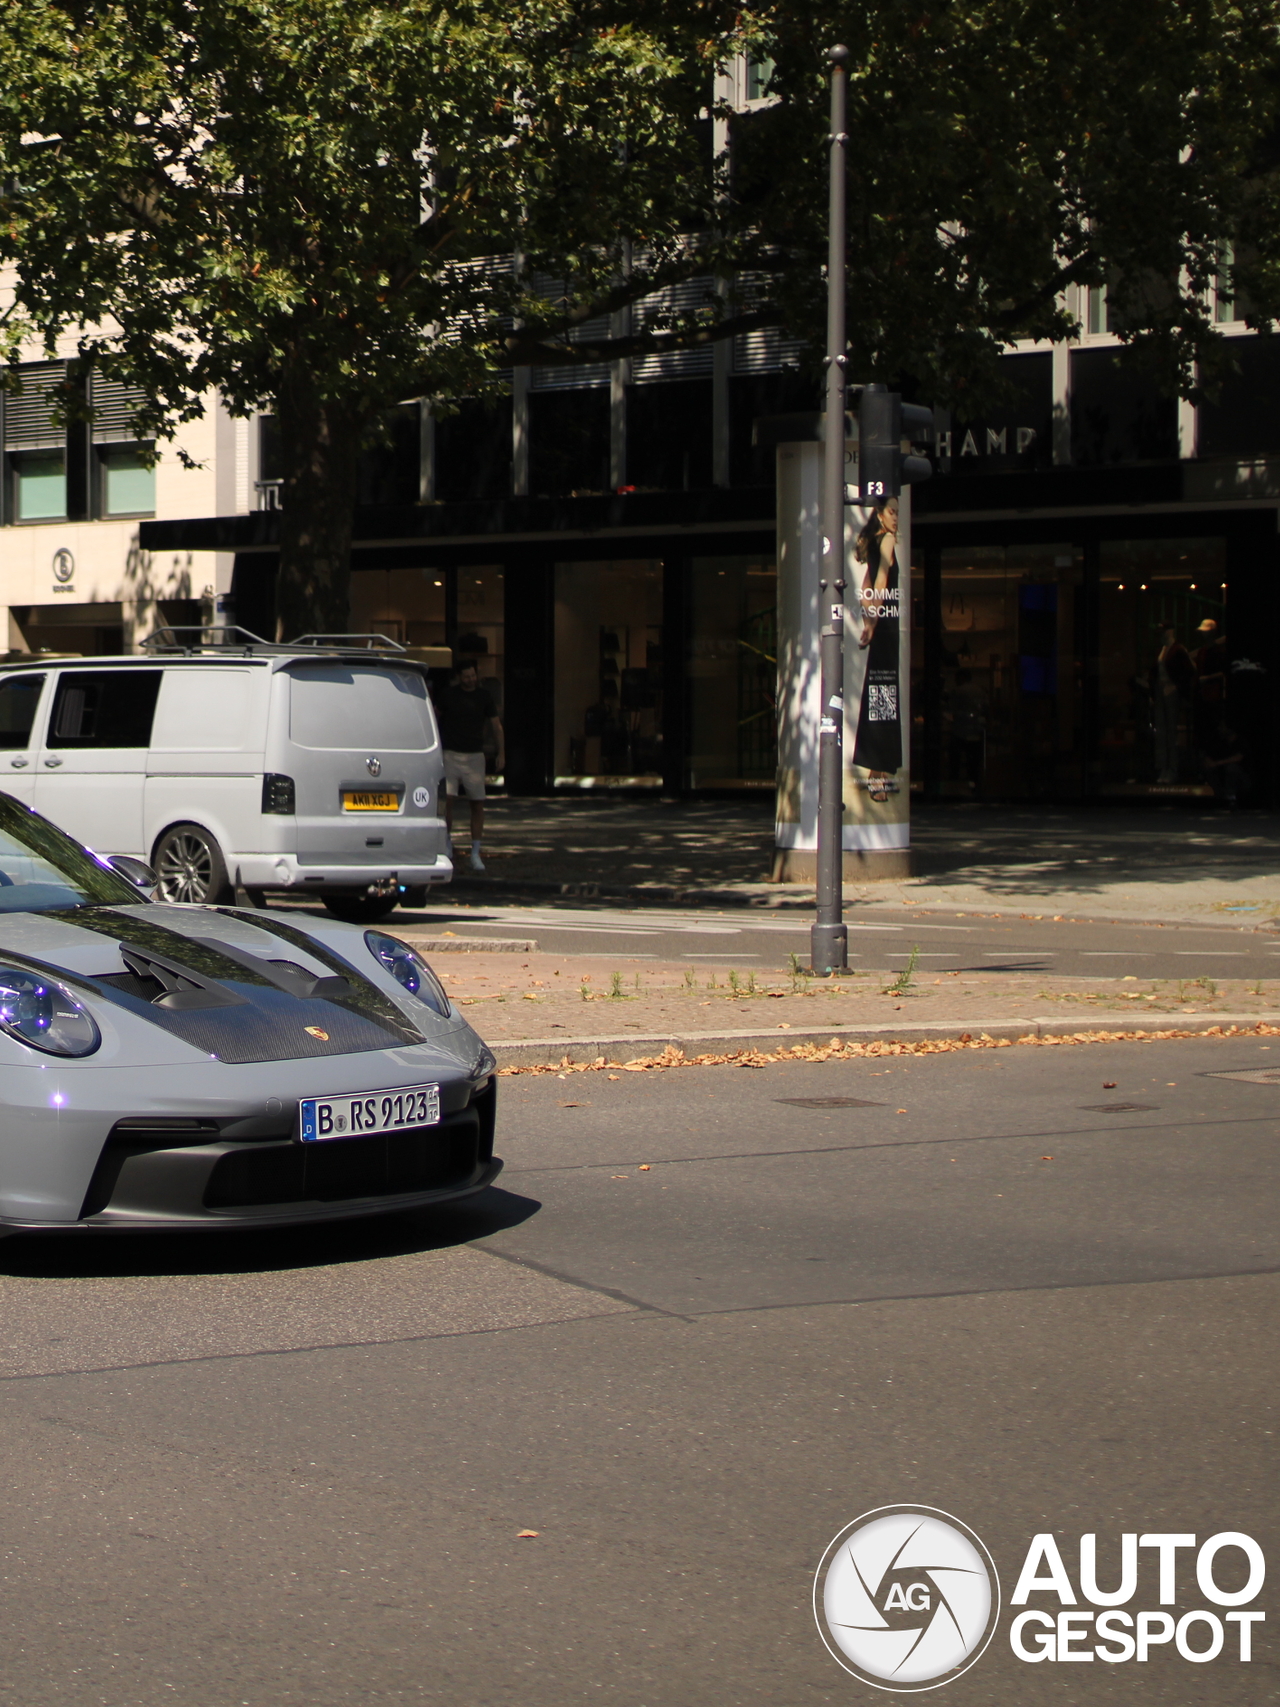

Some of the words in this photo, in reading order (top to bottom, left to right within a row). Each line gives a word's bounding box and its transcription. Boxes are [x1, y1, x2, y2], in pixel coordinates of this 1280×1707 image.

[868, 482, 883, 495] F3
[372, 795, 390, 806] XGJ
[416, 792, 426, 802] UK
[318, 1104, 333, 1134] B
[350, 1099, 376, 1131] RS
[381, 1092, 427, 1127] 9123
[306, 1125, 312, 1133] D
